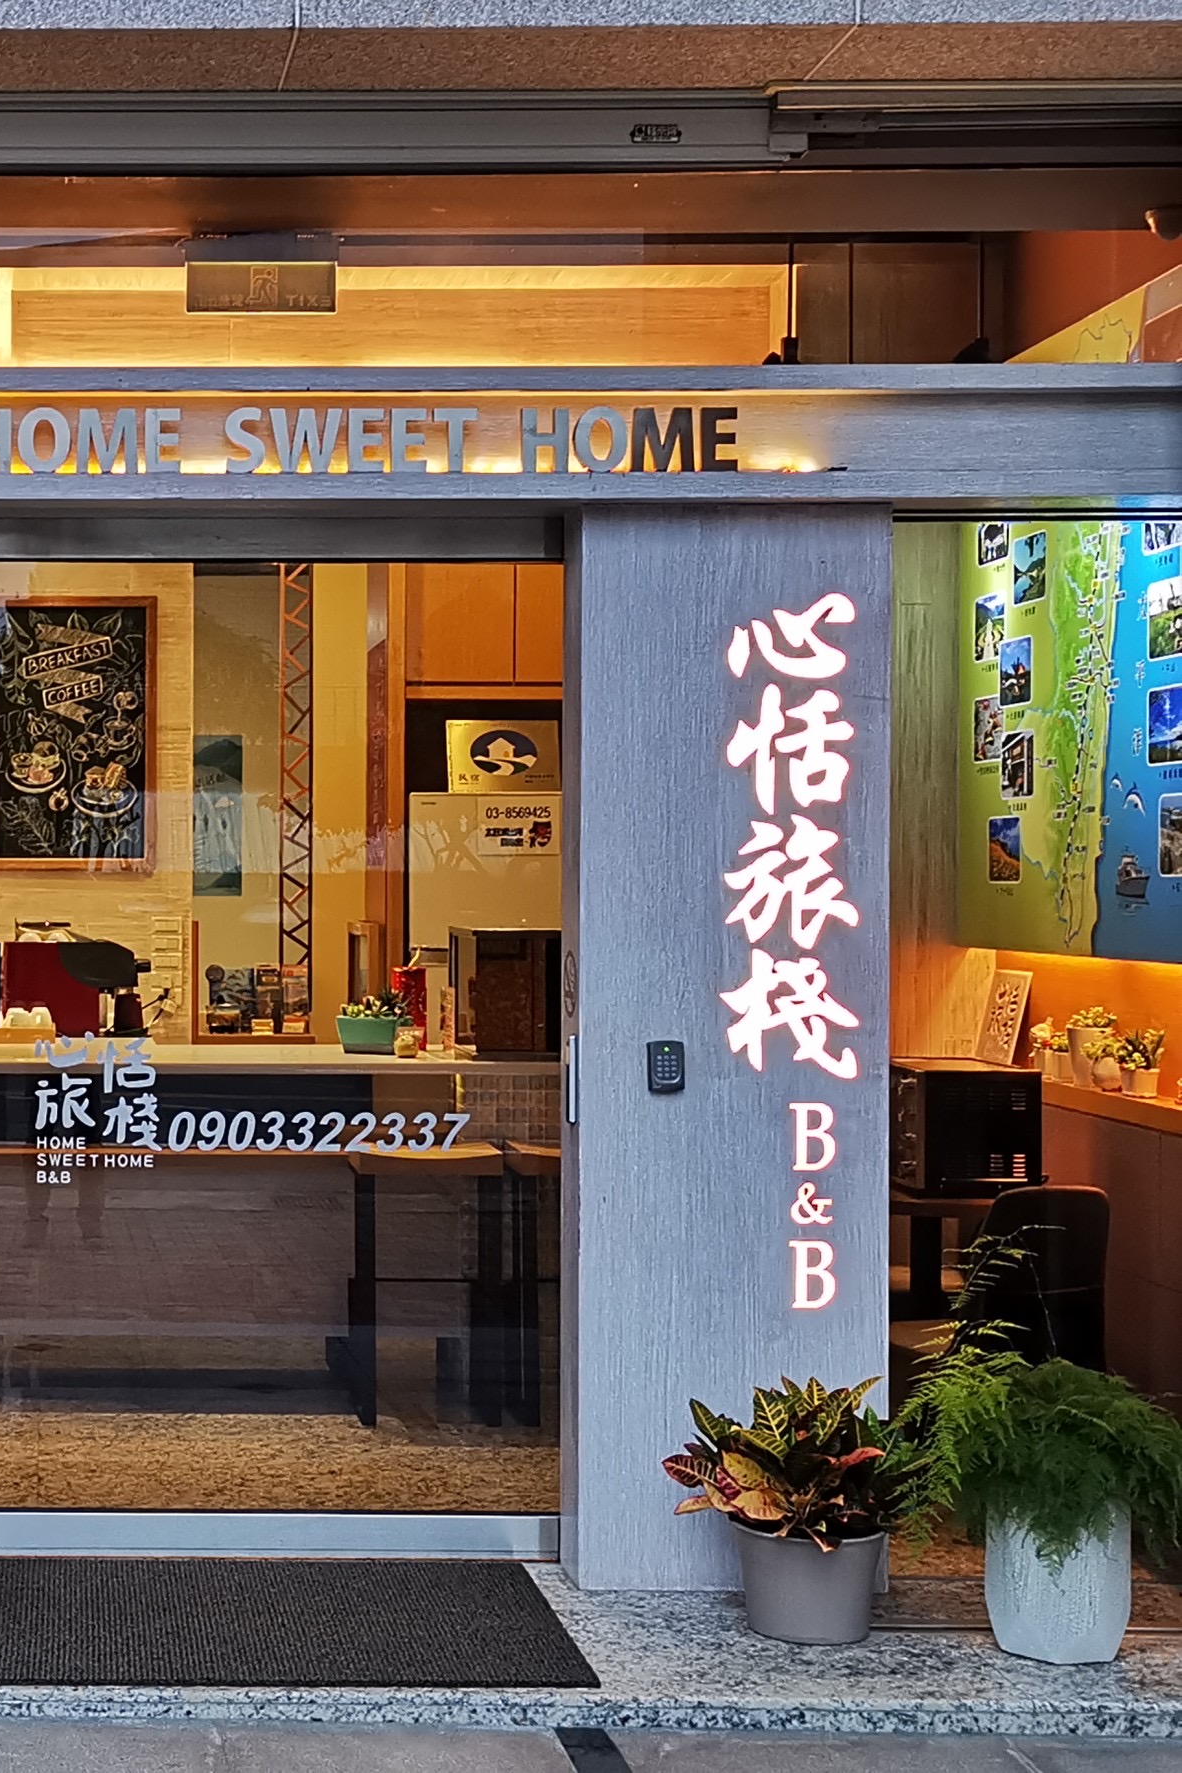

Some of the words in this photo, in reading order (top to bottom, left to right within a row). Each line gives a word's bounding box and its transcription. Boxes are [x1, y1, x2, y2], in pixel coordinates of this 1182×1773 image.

[223, 406, 479, 473] SWEET
[521, 406, 739, 473] HOME
[28, 641, 108, 674] BREAKFAST
[47, 680, 99, 704] COFFEE
[485, 806, 552, 820] 03-8569425
[719, 592, 860, 1081] 心恬旅棧
[36, 1136, 86, 1150] HOME
[168, 1111, 470, 1152] 0903322337
[36, 1154, 99, 1167] SWEET
[104, 1154, 154, 1168] HOME
[36, 1171, 71, 1184] B&B
[788, 1102, 837, 1309] B&B
